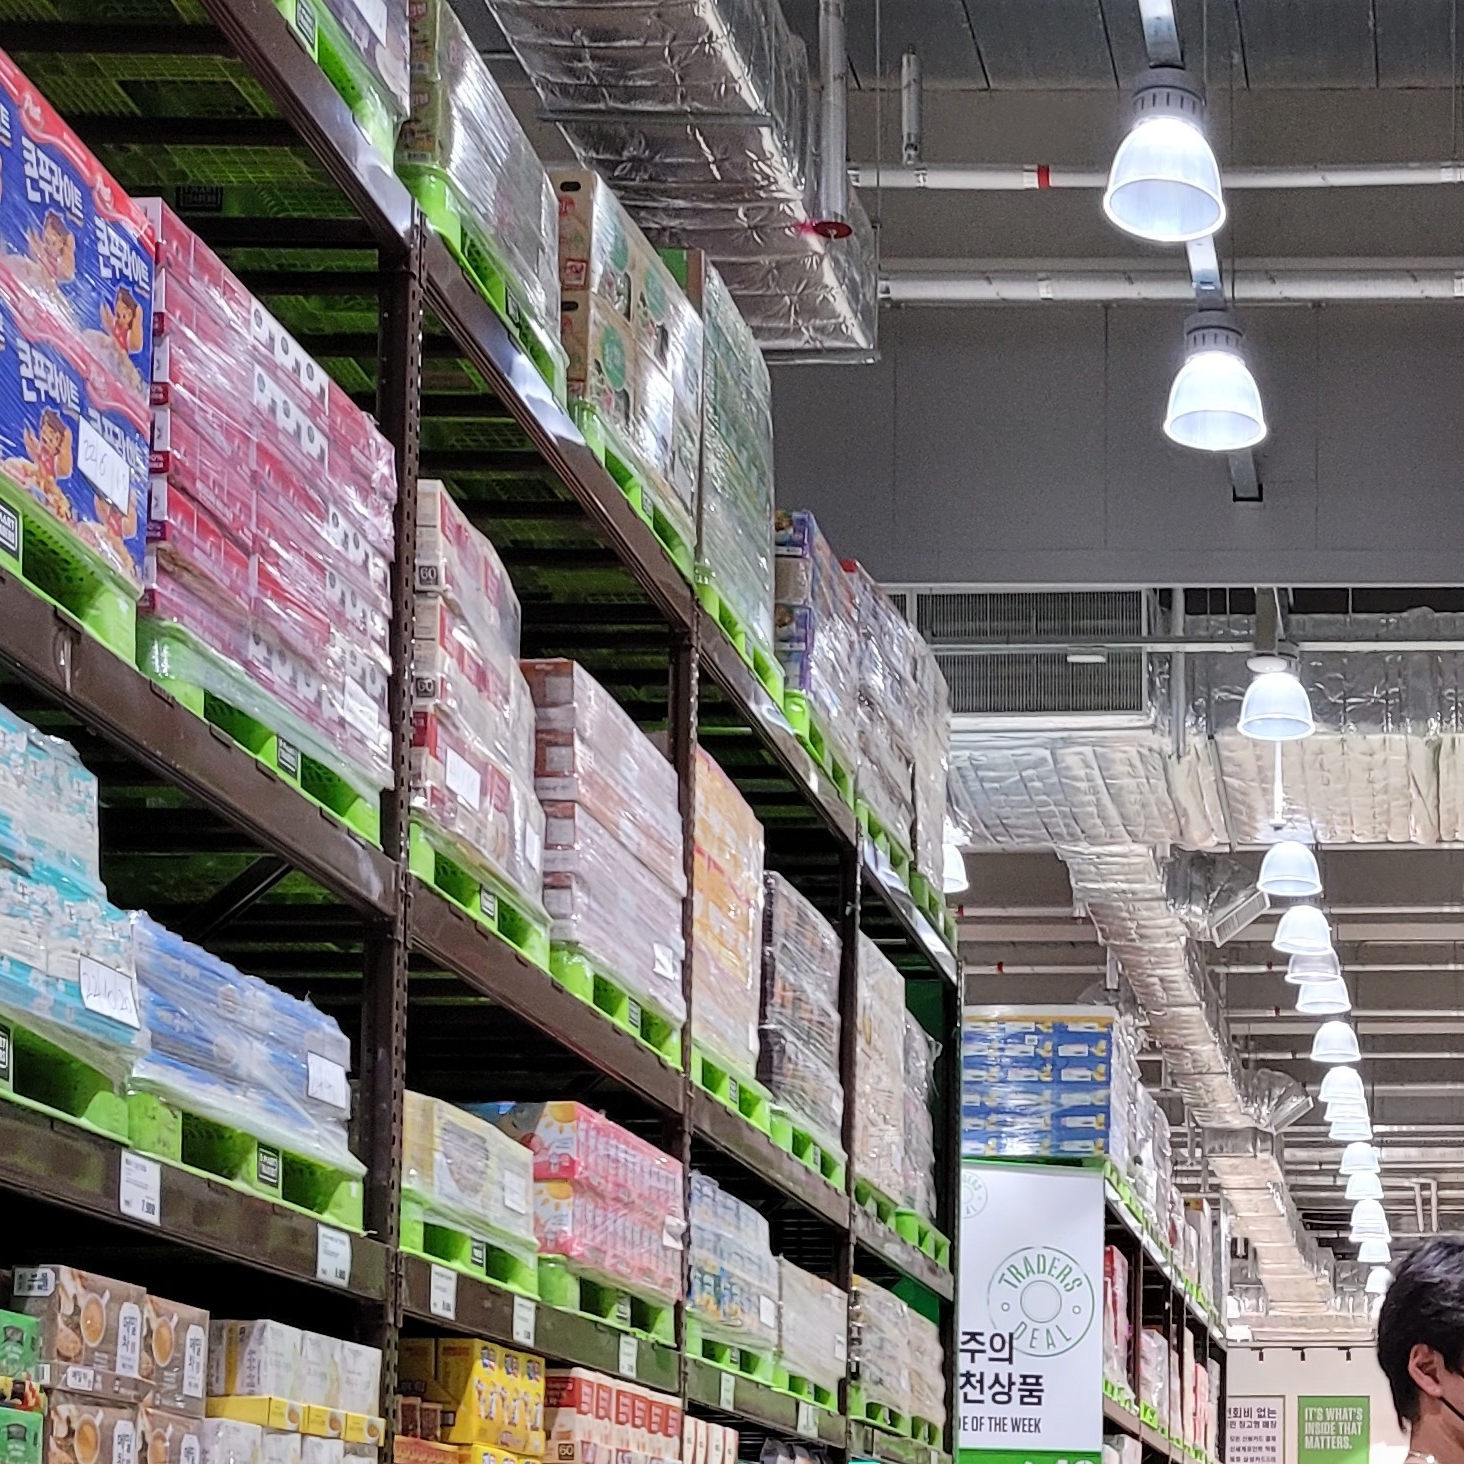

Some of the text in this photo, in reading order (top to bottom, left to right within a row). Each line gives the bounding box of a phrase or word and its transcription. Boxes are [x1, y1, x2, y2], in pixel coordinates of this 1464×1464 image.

[22, 136, 84, 219] 콘푸라이트
[94, 215, 149, 291] 콘푸라이트
[16, 337, 80, 413] 콘푸라이트
[998, 1253, 1083, 1293] TRADERS
[959, 1331, 1014, 1365] 주의
[1013, 1321, 1072, 1349] DEAL
[959, 1370, 1045, 1406] 천상품
[971, 1416, 985, 1432] OF
[988, 1416, 1008, 1432] THE
[1011, 1417, 1041, 1433] WEEK
[1256, 1407, 1278, 1419] 없는
[1305, 1407, 1364, 1421] IT'S WHAT'S
[1305, 1421, 1363, 1435] INSIDE THAT
[1305, 1436, 1353, 1450] MATTERS.
